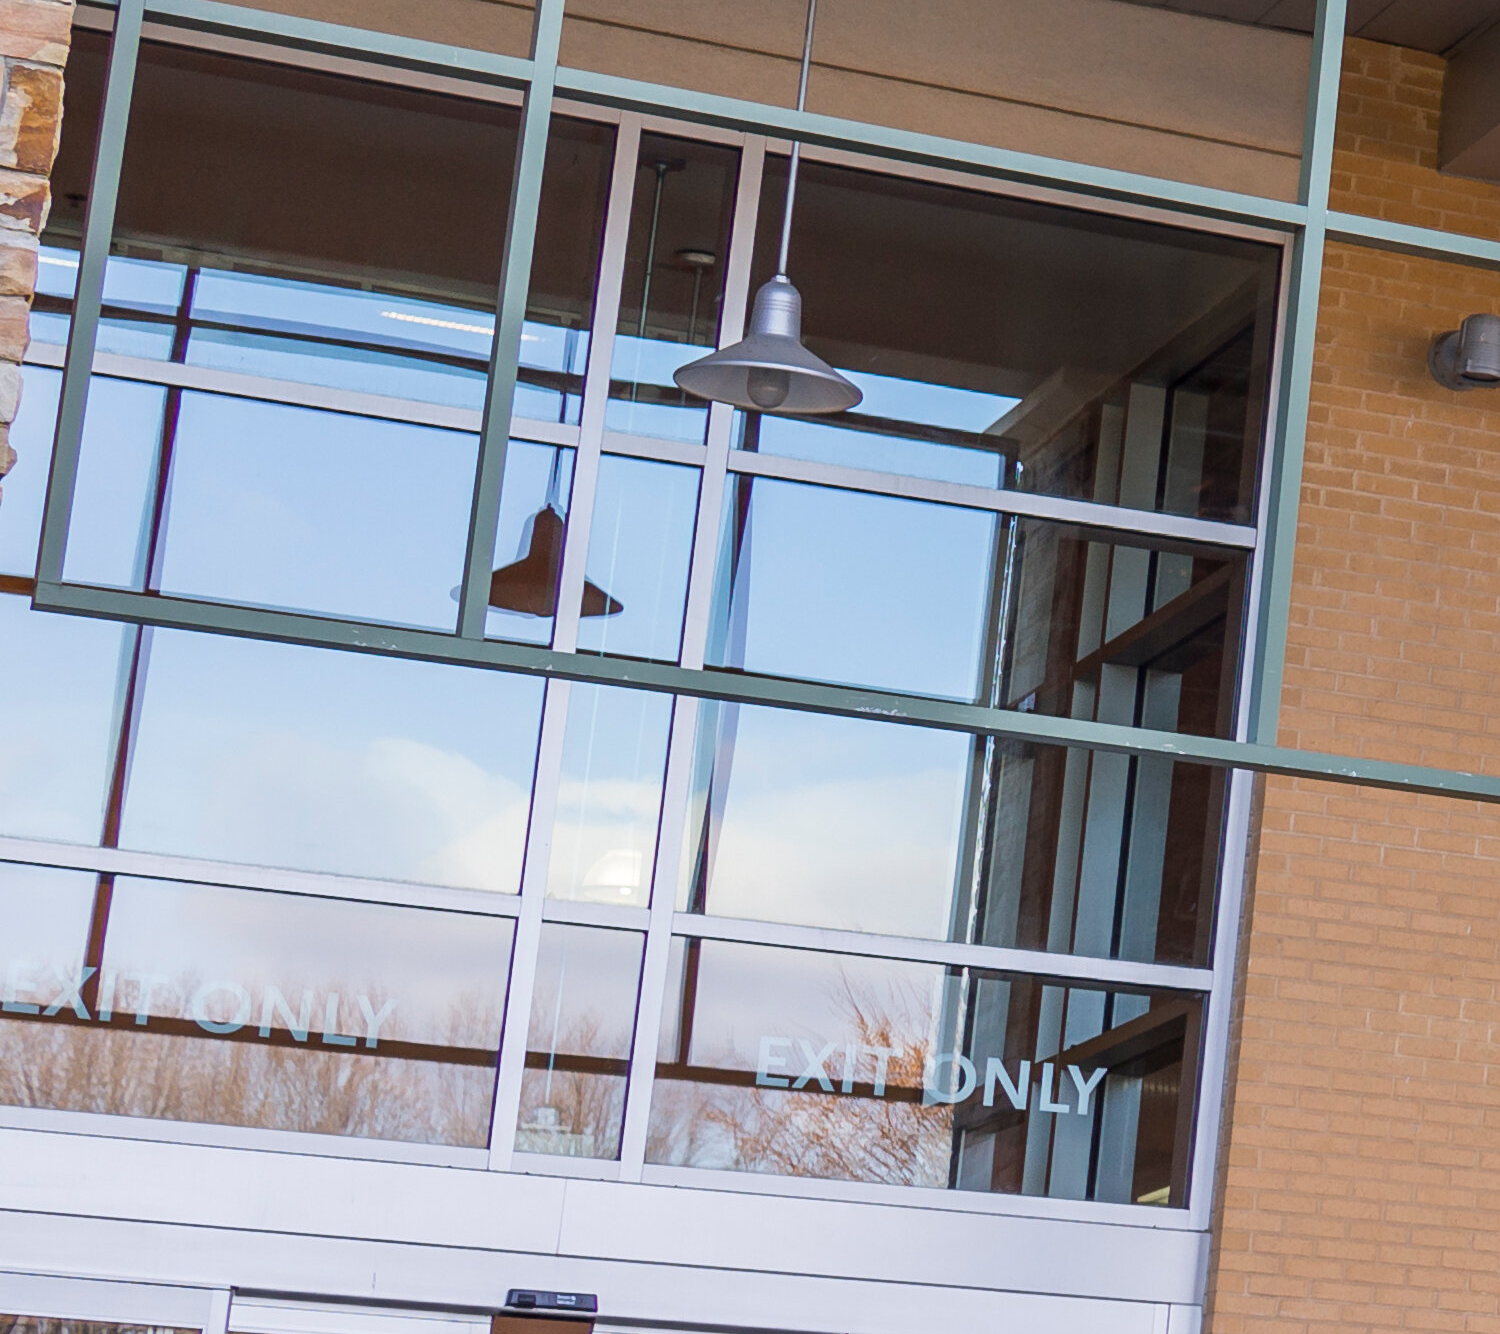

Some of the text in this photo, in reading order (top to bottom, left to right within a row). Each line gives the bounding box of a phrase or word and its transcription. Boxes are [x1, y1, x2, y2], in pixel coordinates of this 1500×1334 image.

[1, 966, 398, 1049] EXIT ONLY
[754, 1036, 1107, 1115] EXIT ONLY
